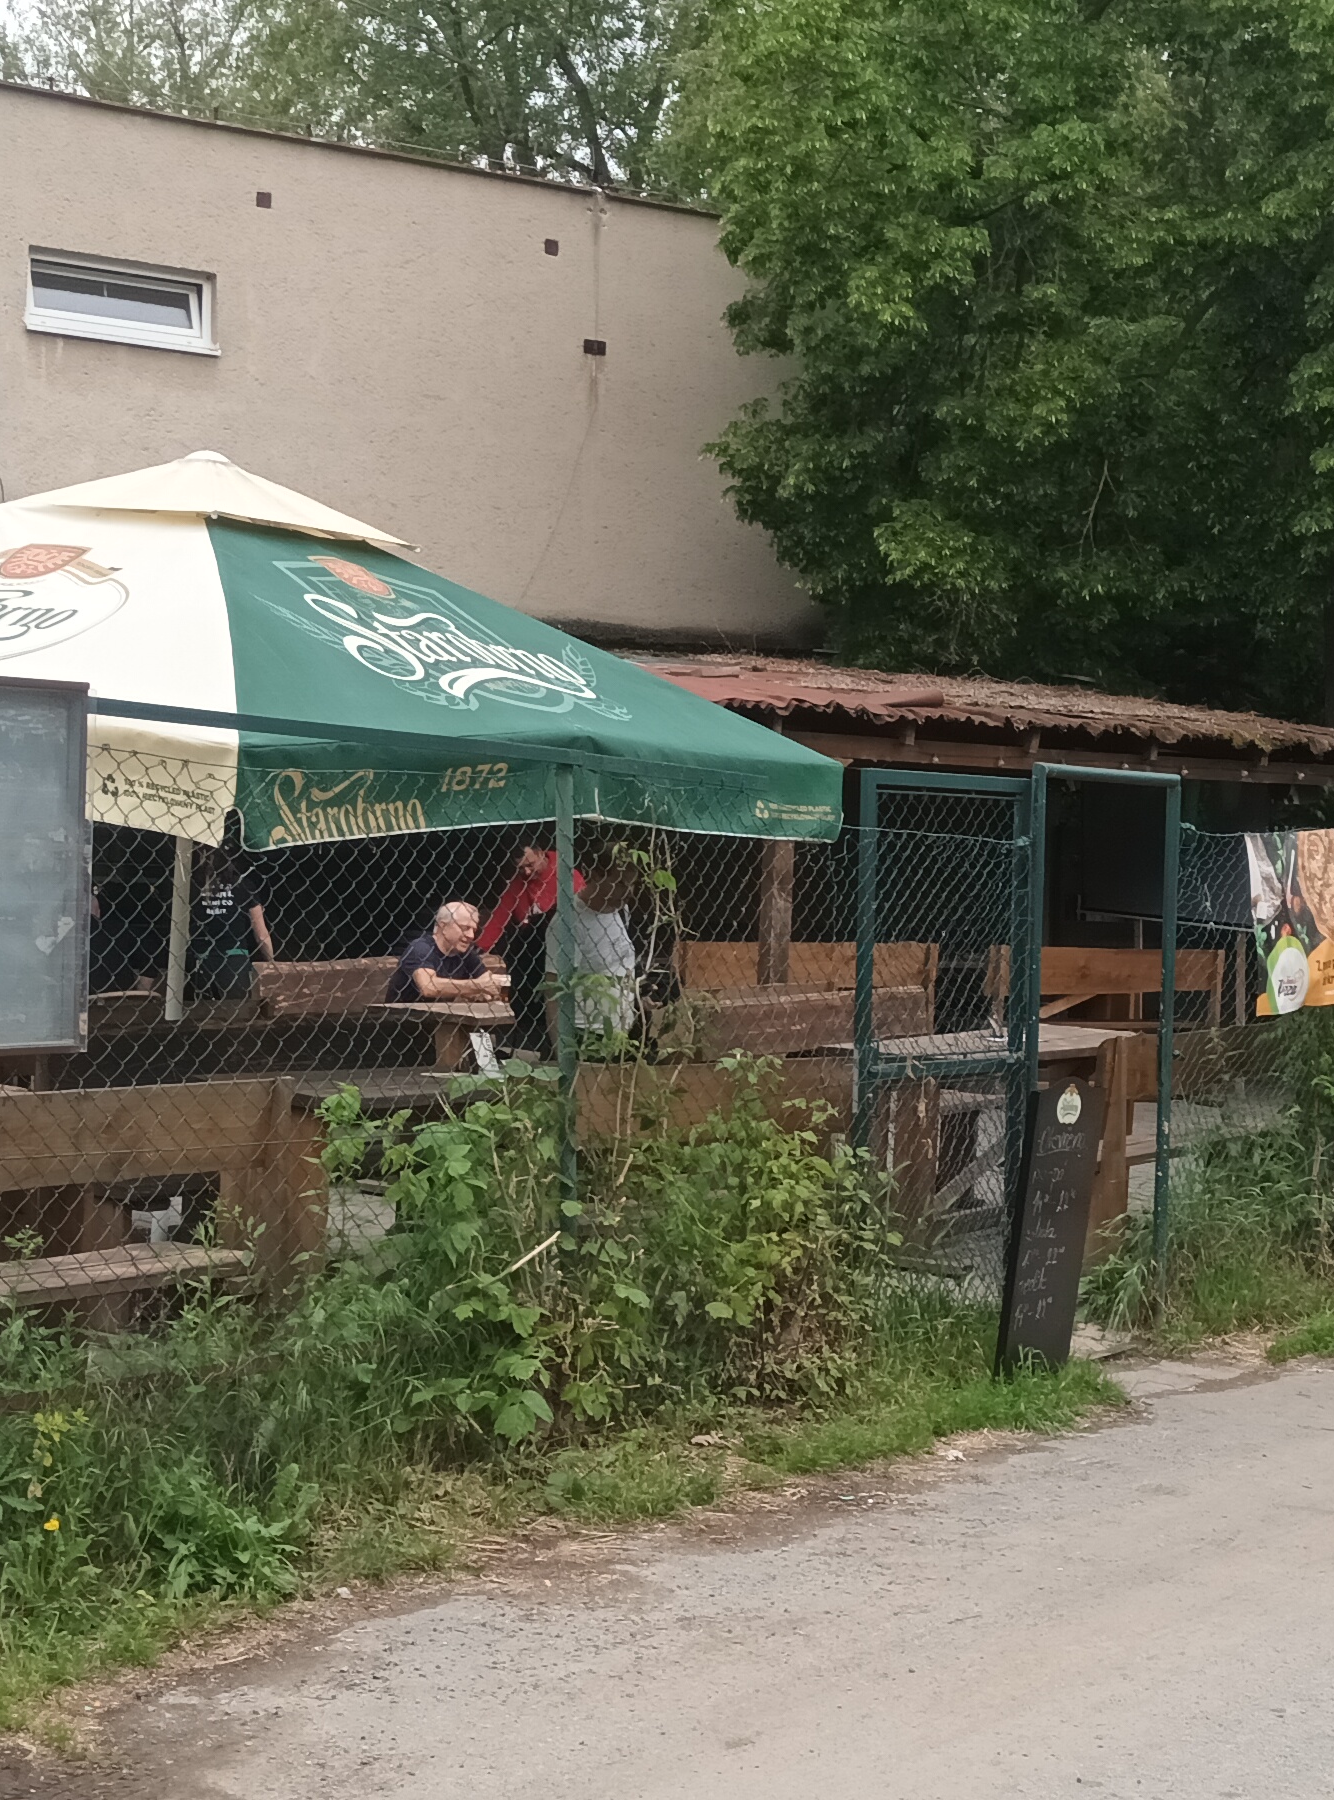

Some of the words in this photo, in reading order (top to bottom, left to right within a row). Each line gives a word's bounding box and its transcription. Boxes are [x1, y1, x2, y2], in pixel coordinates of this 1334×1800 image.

[304, 593, 597, 699] Starobrno
[269, 768, 426, 846] Starobrno
[441, 763, 509, 792] 1872
